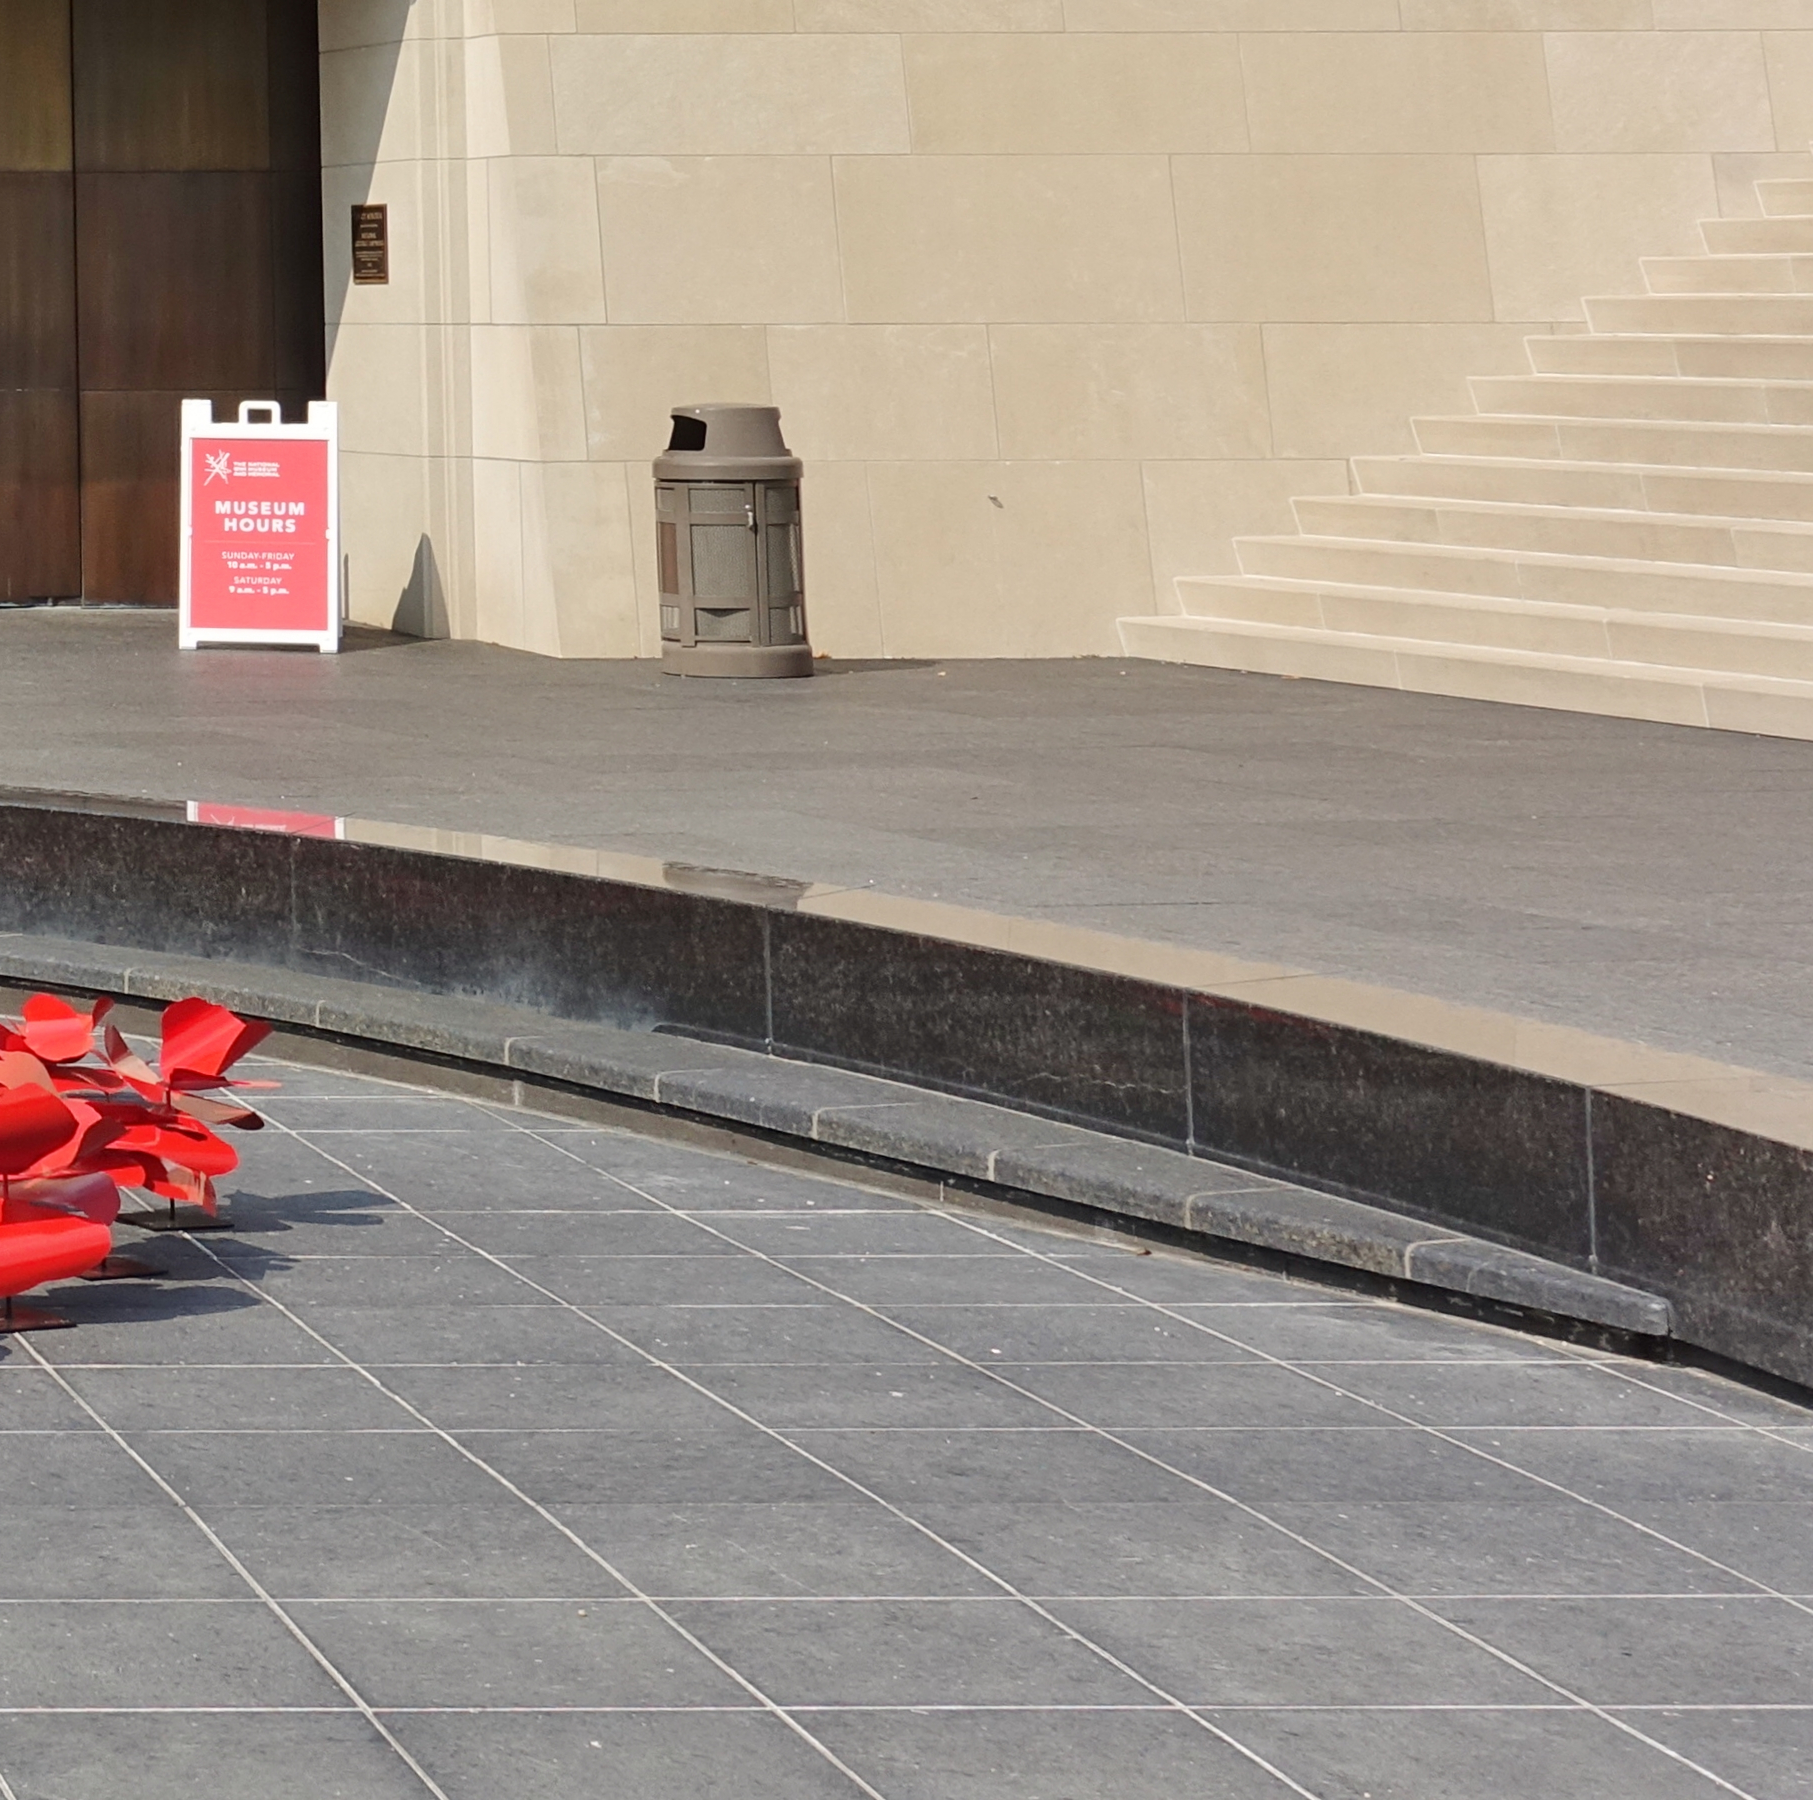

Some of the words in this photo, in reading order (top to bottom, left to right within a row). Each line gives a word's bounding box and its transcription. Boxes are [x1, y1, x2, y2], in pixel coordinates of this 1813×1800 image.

[215, 500, 305, 516] MUSEUM
[224, 518, 296, 533] HOURS
[221, 551, 295, 560] SUNDAY-FRIDAY
[227, 561, 238, 569] 10
[233, 576, 282, 585] SATURDAY
